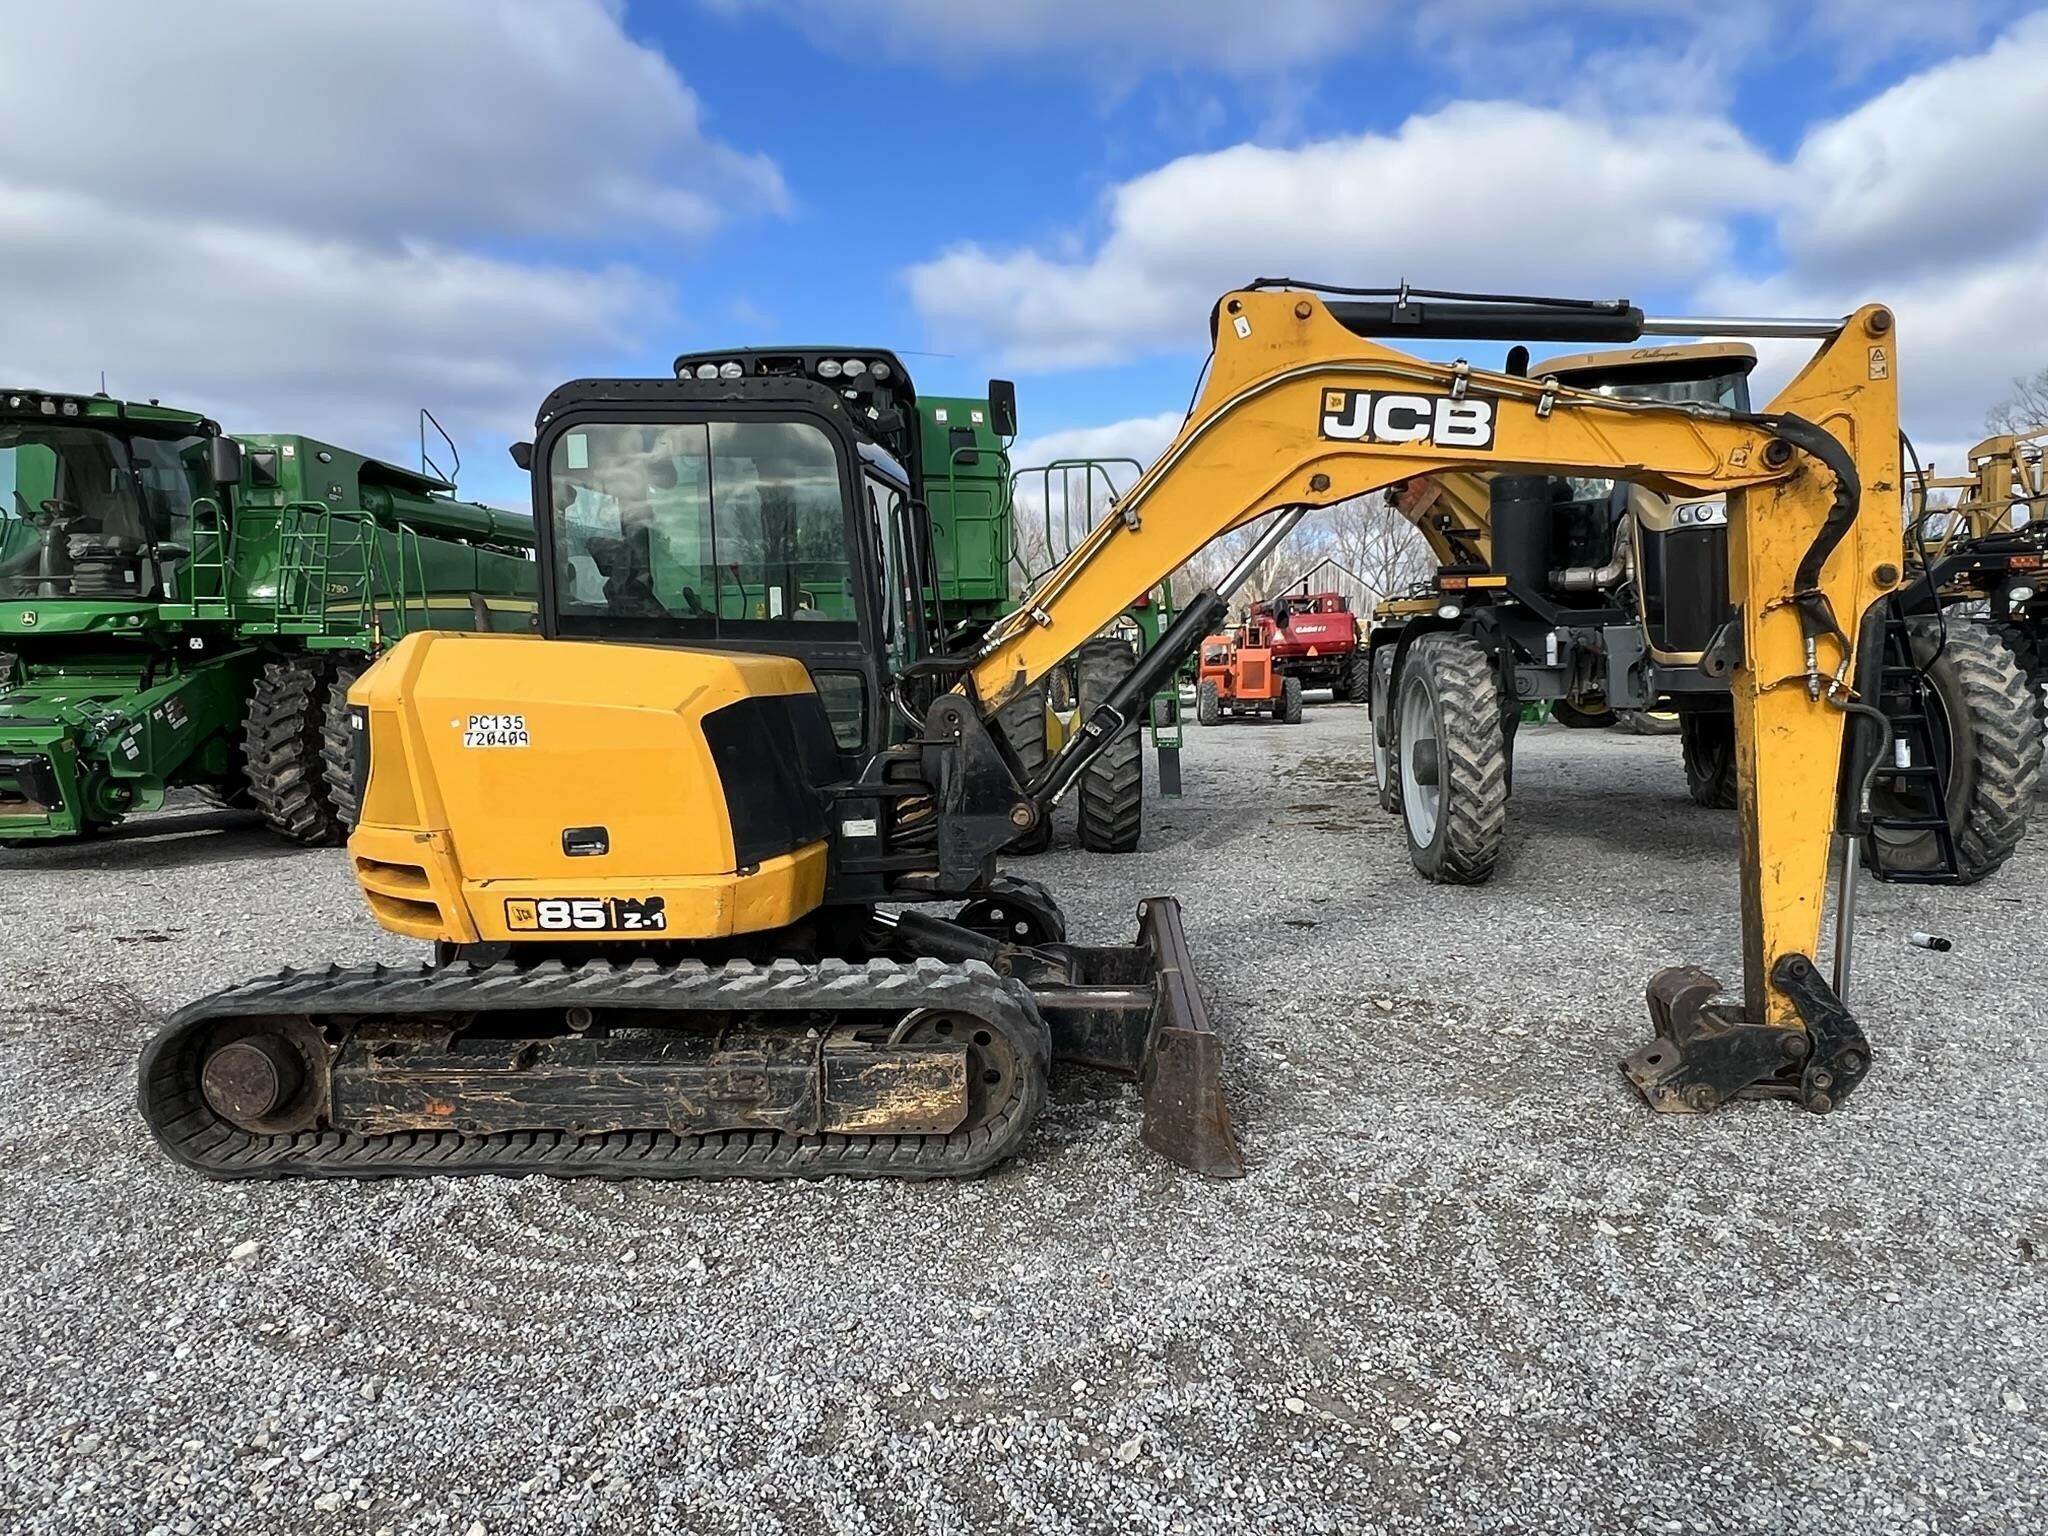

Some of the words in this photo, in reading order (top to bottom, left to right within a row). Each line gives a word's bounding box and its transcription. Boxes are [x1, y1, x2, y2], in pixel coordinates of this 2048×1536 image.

[1323, 393, 1492, 447] JCB
[469, 715, 523, 730] PC135
[464, 731, 529, 746] 720409
[537, 900, 606, 929] 85
